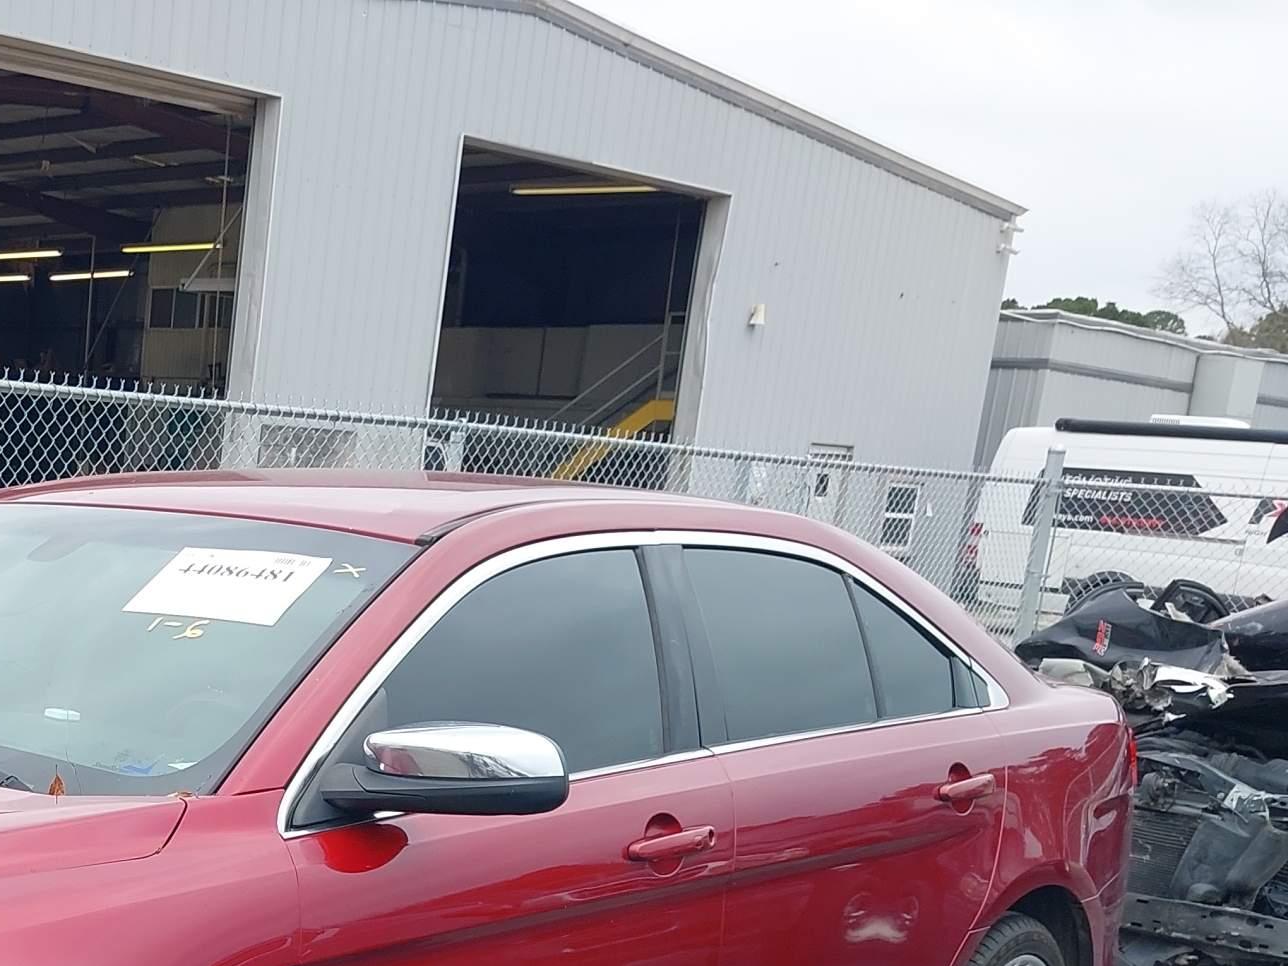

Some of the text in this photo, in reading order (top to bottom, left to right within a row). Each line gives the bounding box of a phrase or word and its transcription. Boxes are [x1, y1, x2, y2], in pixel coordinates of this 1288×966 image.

[1063, 488, 1132, 501] SPECIALISTS
[178, 562, 295, 583] 44086481
[147, 617, 210, 640] 1-6
